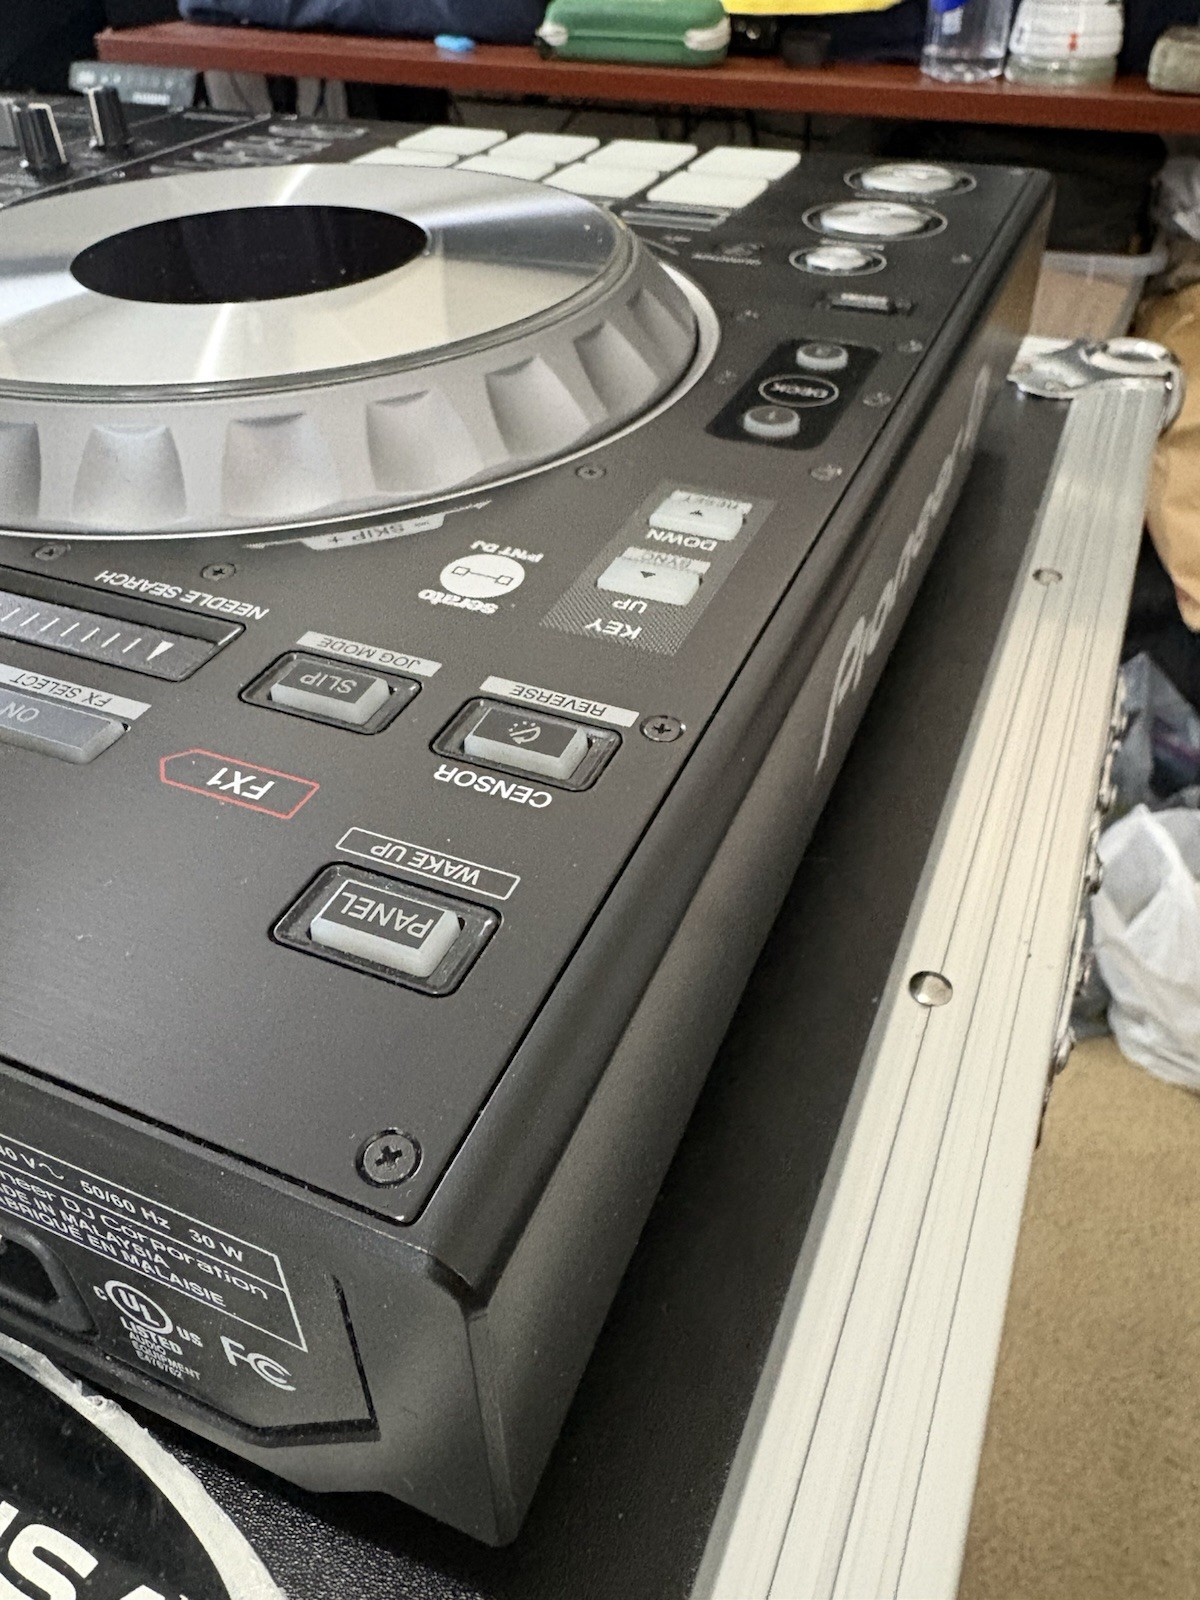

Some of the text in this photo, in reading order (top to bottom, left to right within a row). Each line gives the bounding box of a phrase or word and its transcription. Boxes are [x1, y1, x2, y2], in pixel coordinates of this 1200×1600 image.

[351, 523, 405, 542] SKIP
[644, 528, 718, 551] DOWN
[94, 569, 271, 620] NEEDLE SEARCH
[418, 589, 499, 614] serato
[611, 598, 649, 614] UP
[585, 618, 643, 640] KEY
[316, 636, 422, 670] JOG MODE
[9, 672, 113, 708] FX SELECT
[300, 670, 357, 695] SLIP
[0, 701, 41, 722] ON
[508, 684, 608, 718] REVERSE
[205, 766, 276, 801] FX1
[433, 763, 553, 809] CENSOR
[369, 842, 481, 886] WAKE UP
[340, 891, 435, 939] PANEL
[20, 1152, 35, 1169] V
[80, 1180, 136, 1214] 50/60
[140, 1207, 171, 1231] Hz
[188, 1229, 216, 1250] 30
[219, 1242, 244, 1263] W
[0, 1182, 170, 1270] DE IN MALAYSIA
[60, 1195, 96, 1220] DJ
[99, 1214, 269, 1300] Corporation
[86, 1233, 118, 1257] EN
[120, 1249, 227, 1308] MALAISIE
[118, 1288, 161, 1327] UL
[175, 1325, 204, 1348] US
[120, 1316, 184, 1356] LISTED
[129, 1331, 167, 1356] AUDIO
[131, 1340, 201, 1381] EQUIPMENT
